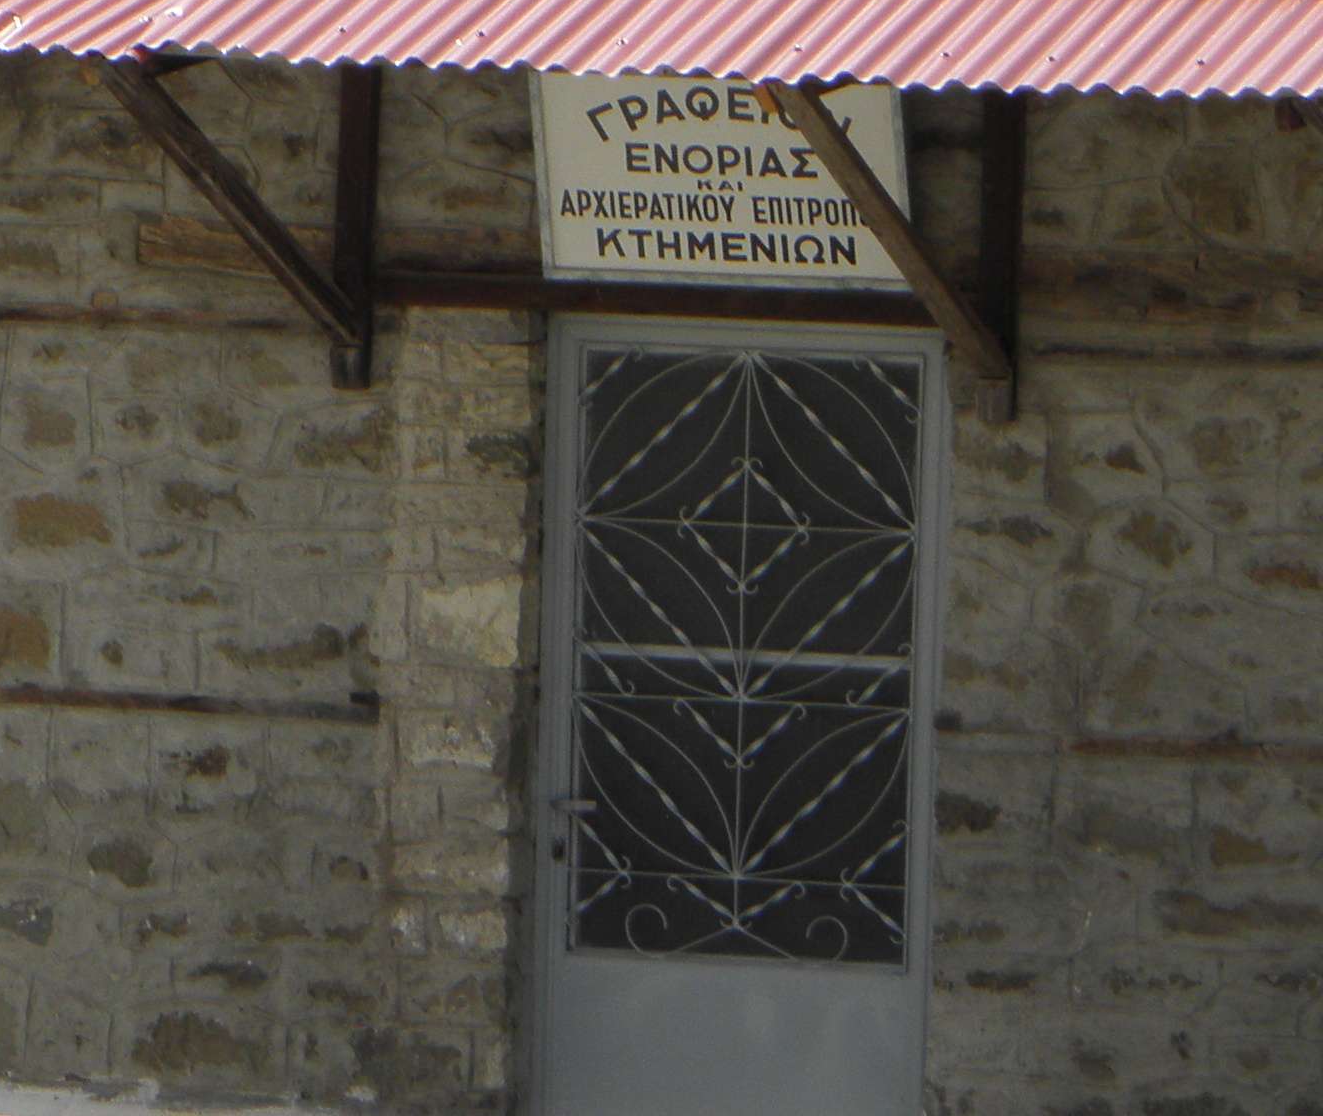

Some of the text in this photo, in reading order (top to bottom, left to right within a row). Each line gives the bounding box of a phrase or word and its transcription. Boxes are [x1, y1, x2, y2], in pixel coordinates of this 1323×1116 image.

[586, 85, 852, 142] ΓΡΑΦΕ
[625, 142, 818, 178] ΕΝΟΡΙΑΣ
[697, 179, 743, 192] ΚΑΙ
[560, 189, 868, 226] ΑΡΧΙΕΡΑΤΙΚΟΥ ΕΠΙΤΡΟΠ
[596, 227, 857, 266] ΚΤΗΜΕΝΙΩΝ
